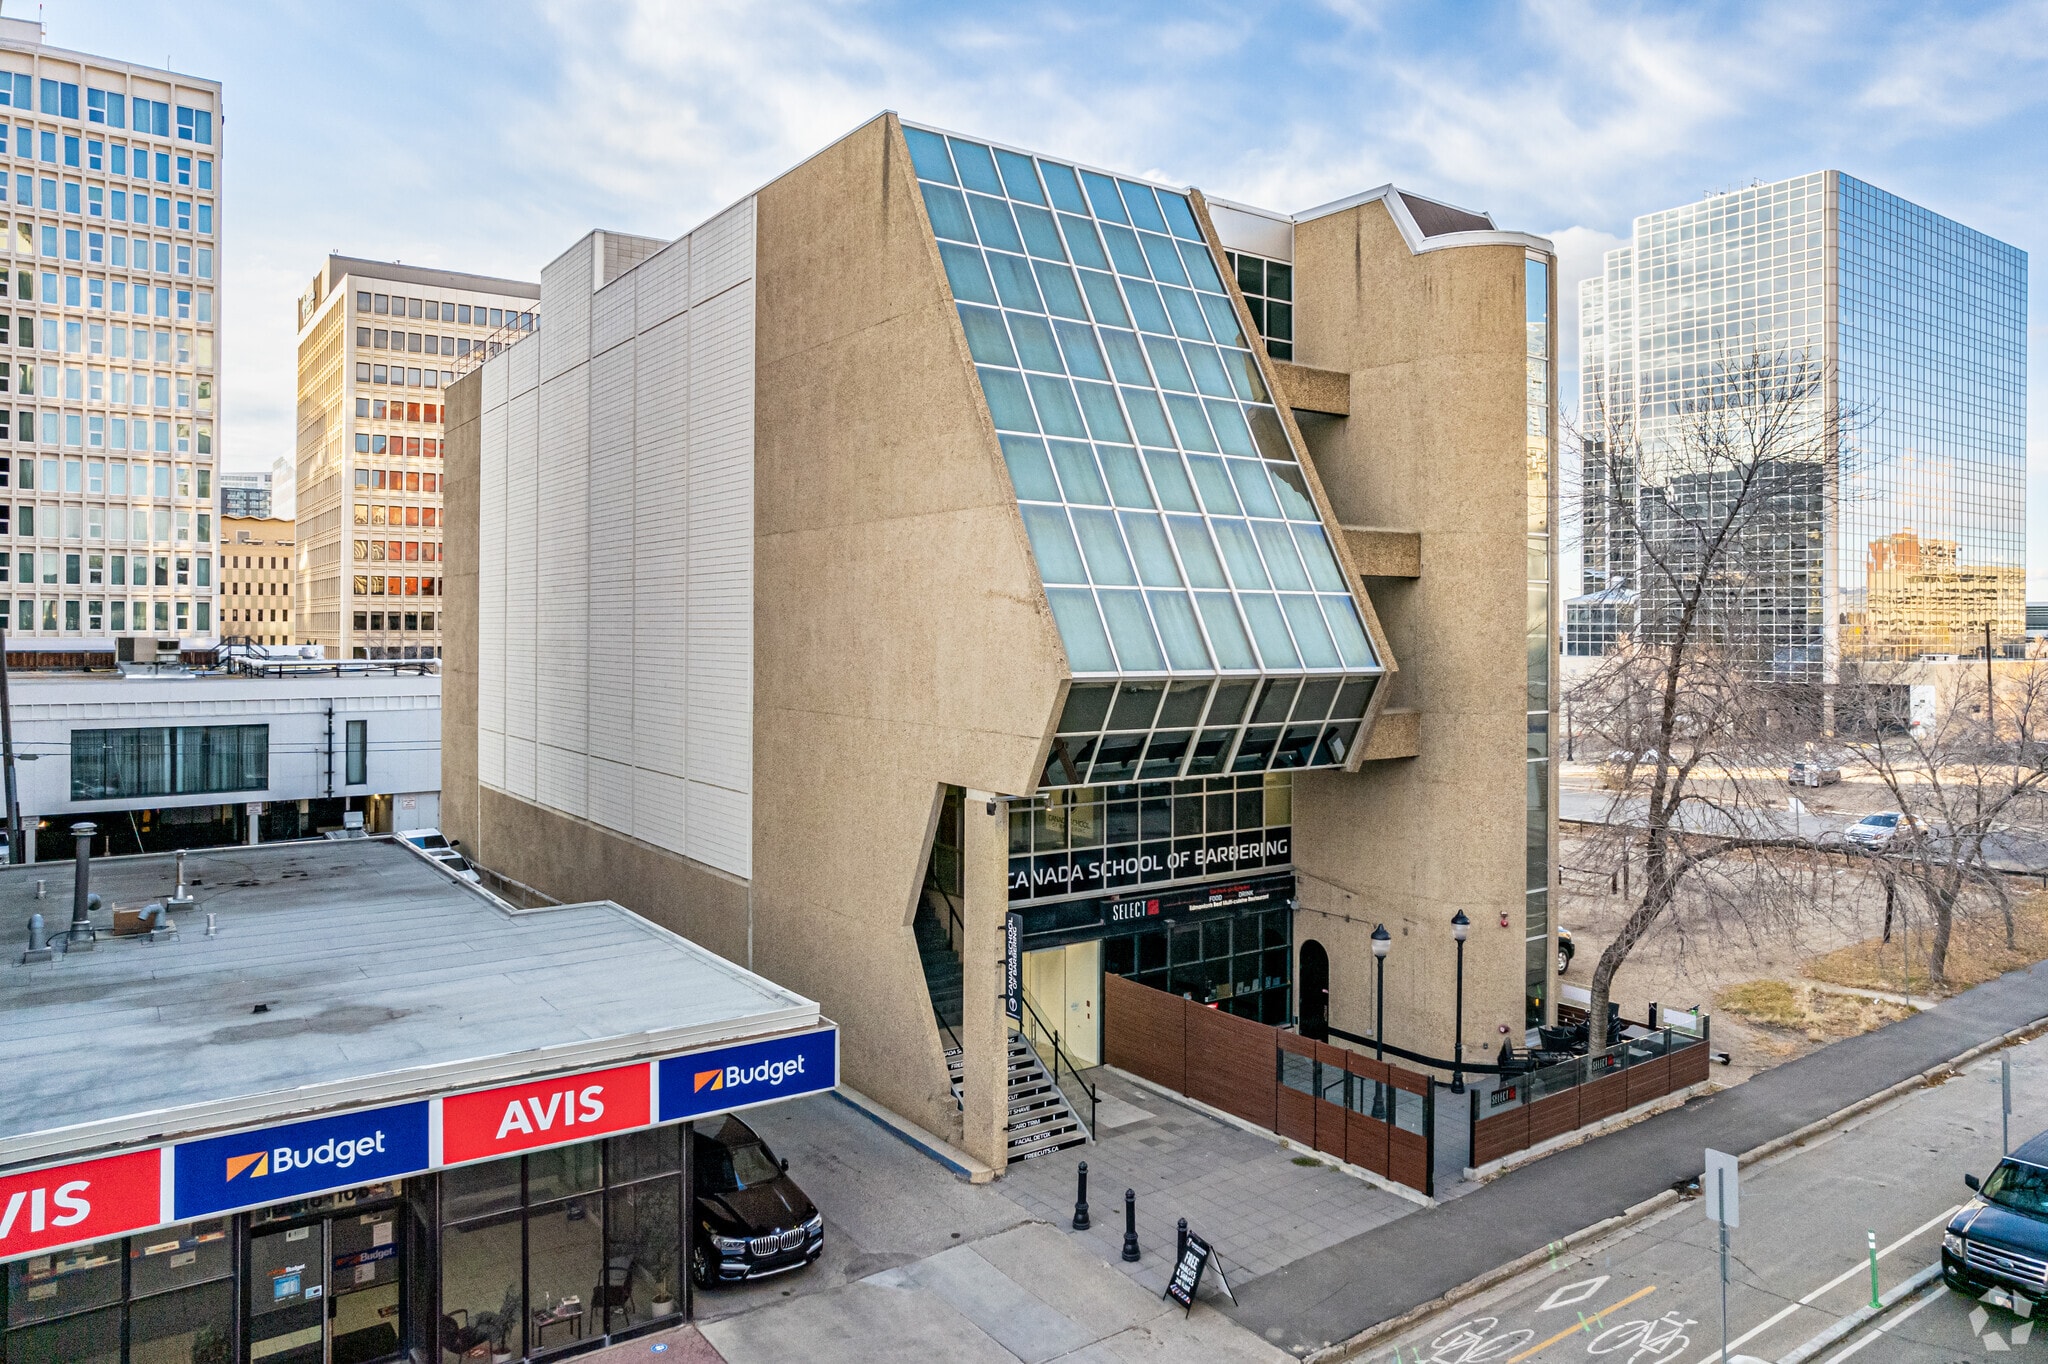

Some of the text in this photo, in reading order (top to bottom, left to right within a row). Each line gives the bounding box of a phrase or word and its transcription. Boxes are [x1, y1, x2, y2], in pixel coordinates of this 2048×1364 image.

[1088, 855, 1163, 879] SCHOOL
[1167, 851, 1190, 869] OF
[1195, 839, 1288, 866] BARBERING
[1208, 894, 1223, 902] FOOD
[1238, 890, 1254, 898] DRINK
[1112, 900, 1147, 921] SELECT
[1012, 978, 1018, 990] OF
[727, 1055, 805, 1088] Budget
[1491, 1089, 1508, 1105] SELECT
[496, 1086, 605, 1139] AVIS
[1027, 1118, 1041, 1127] TRIM
[1014, 1131, 1051, 1146] FACIAL DETOX
[273, 1130, 386, 1174] Budget
[0, 1180, 91, 1240] VIS
[360, 1247, 393, 1263] Budget
[1184, 1251, 1199, 1270] FREE
[285, 1263, 305, 1273] Budget
